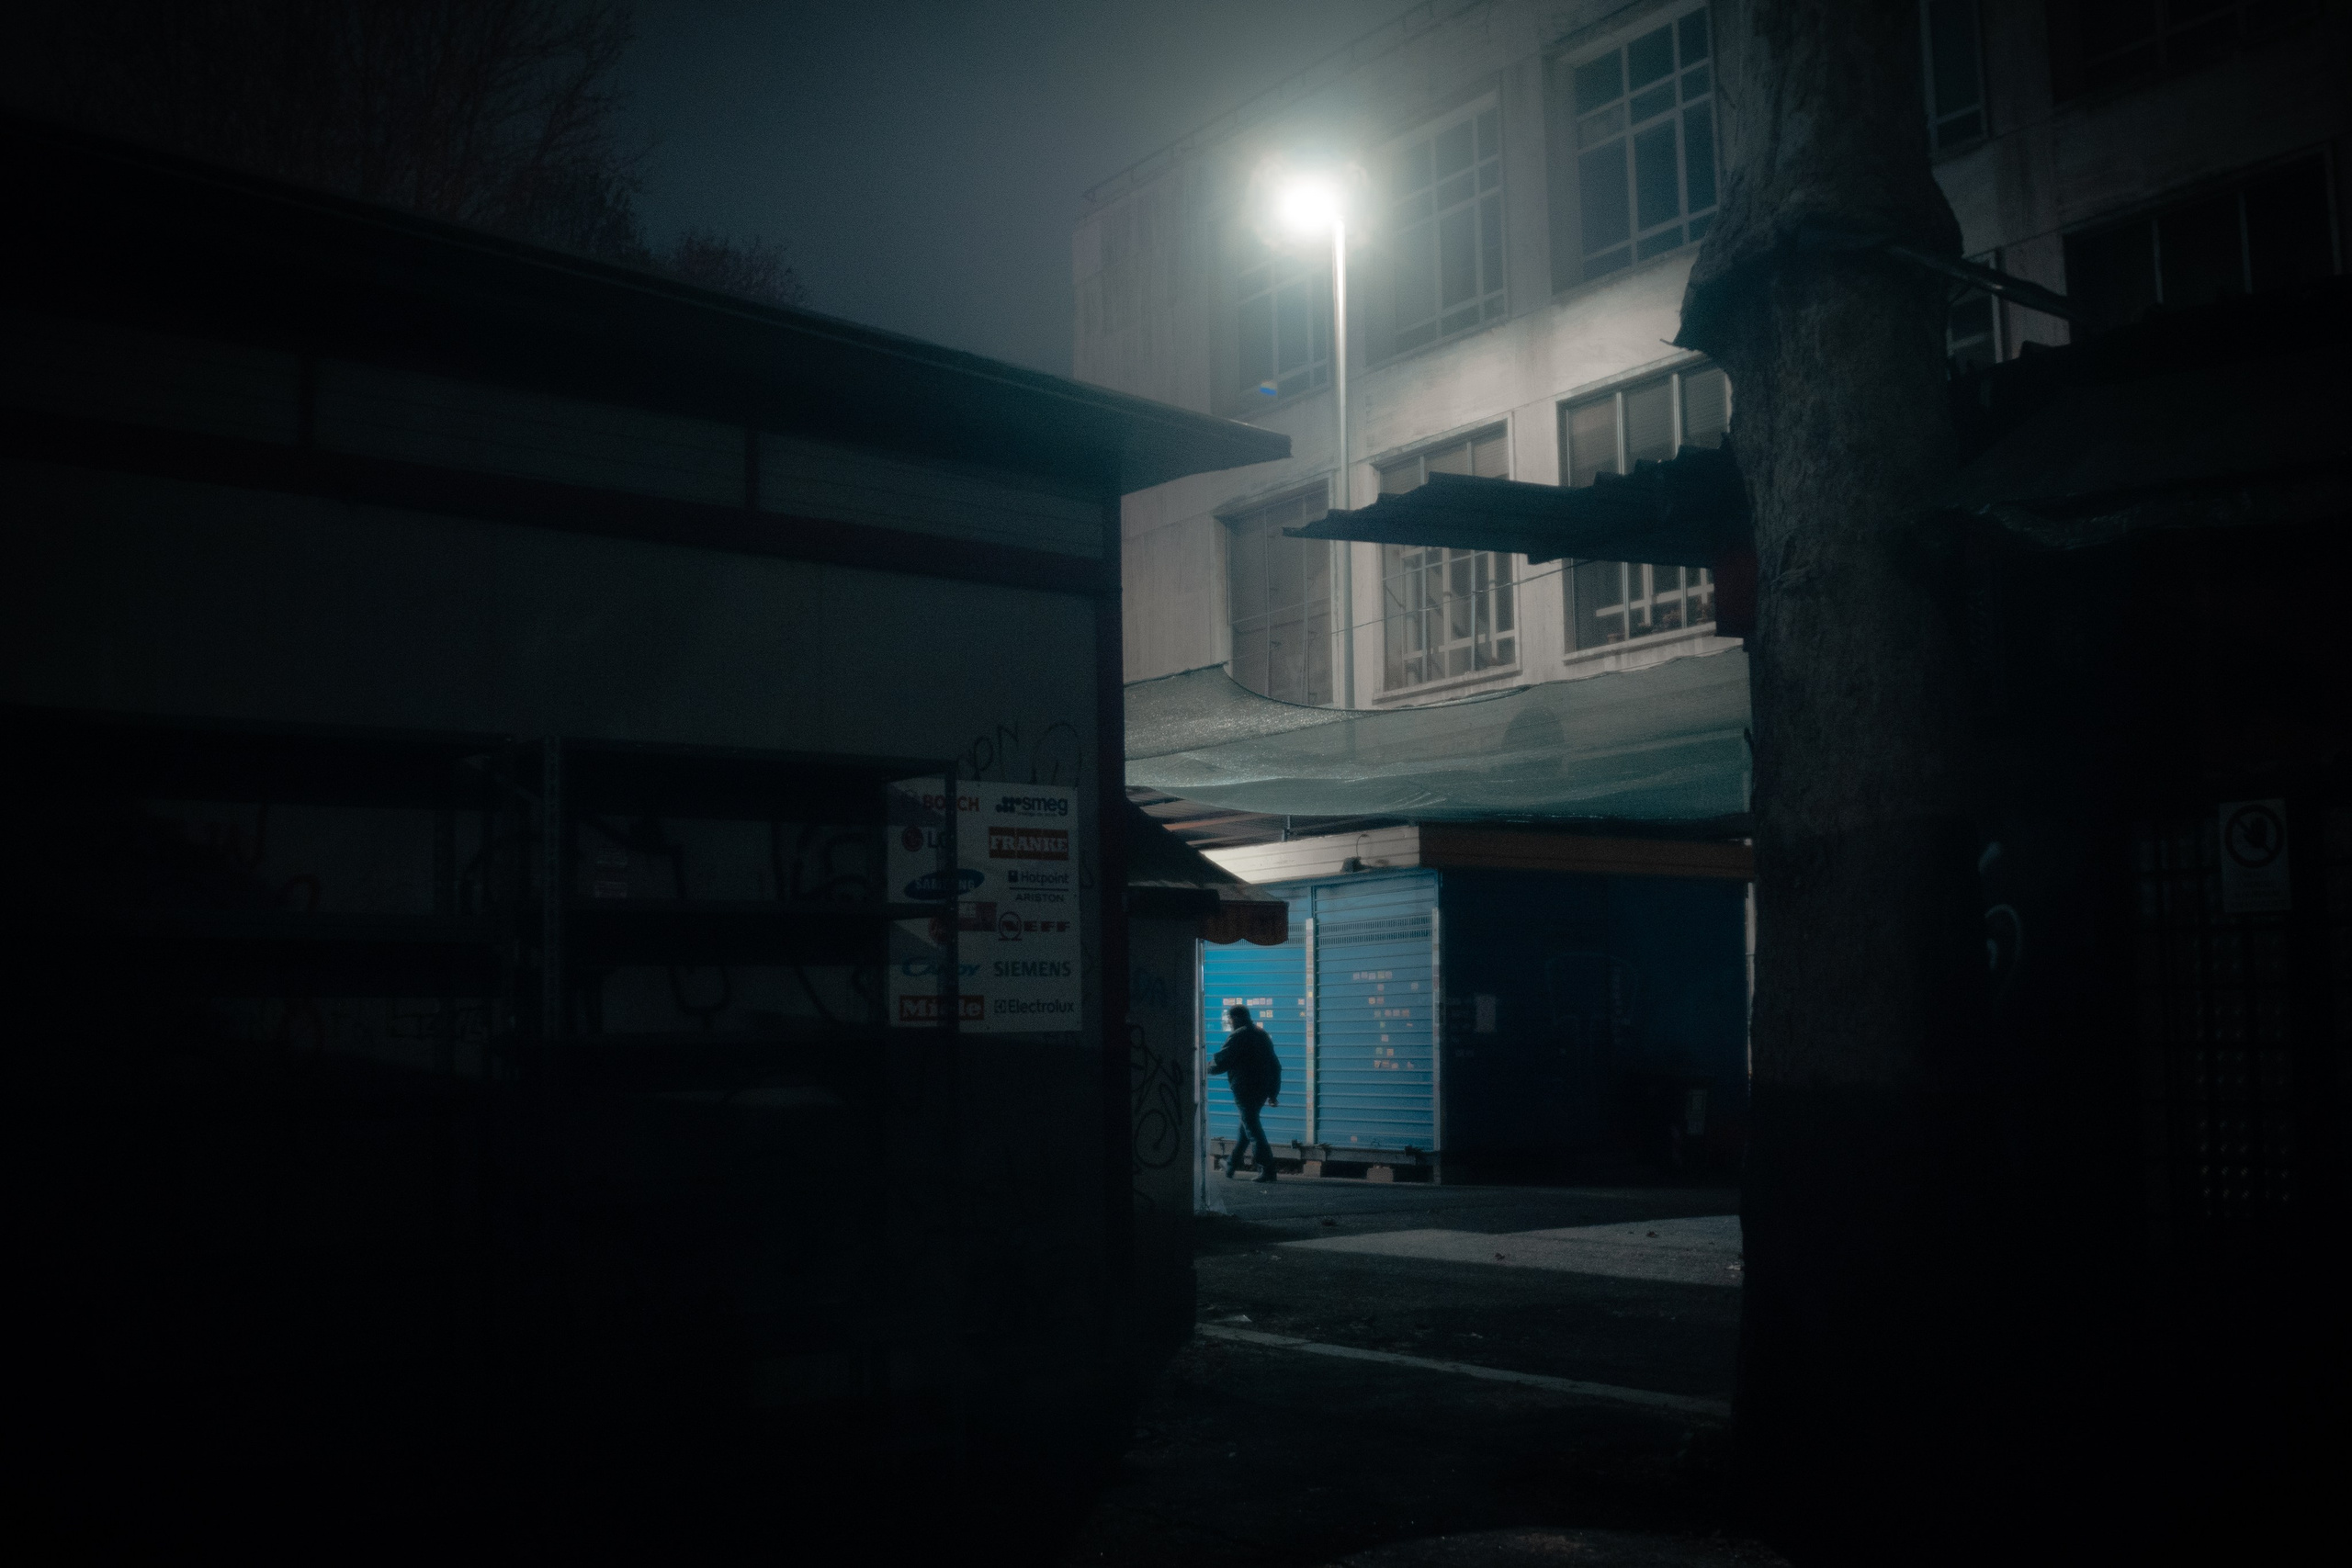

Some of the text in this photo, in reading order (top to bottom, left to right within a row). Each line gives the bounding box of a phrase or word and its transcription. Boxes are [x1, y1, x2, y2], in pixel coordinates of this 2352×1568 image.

[923, 795, 979, 811] BOCH
[1023, 796, 1068, 816] smeg
[989, 835, 1068, 852] FRANKE
[915, 877, 975, 890] SAMNG
[1021, 871, 1069, 886] Hotpoint
[1015, 894, 1064, 903] ARISTON
[1002, 920, 1070, 932] NEFF
[994, 961, 1071, 977] SIEMENS
[1009, 999, 1074, 1014] Electrolux
